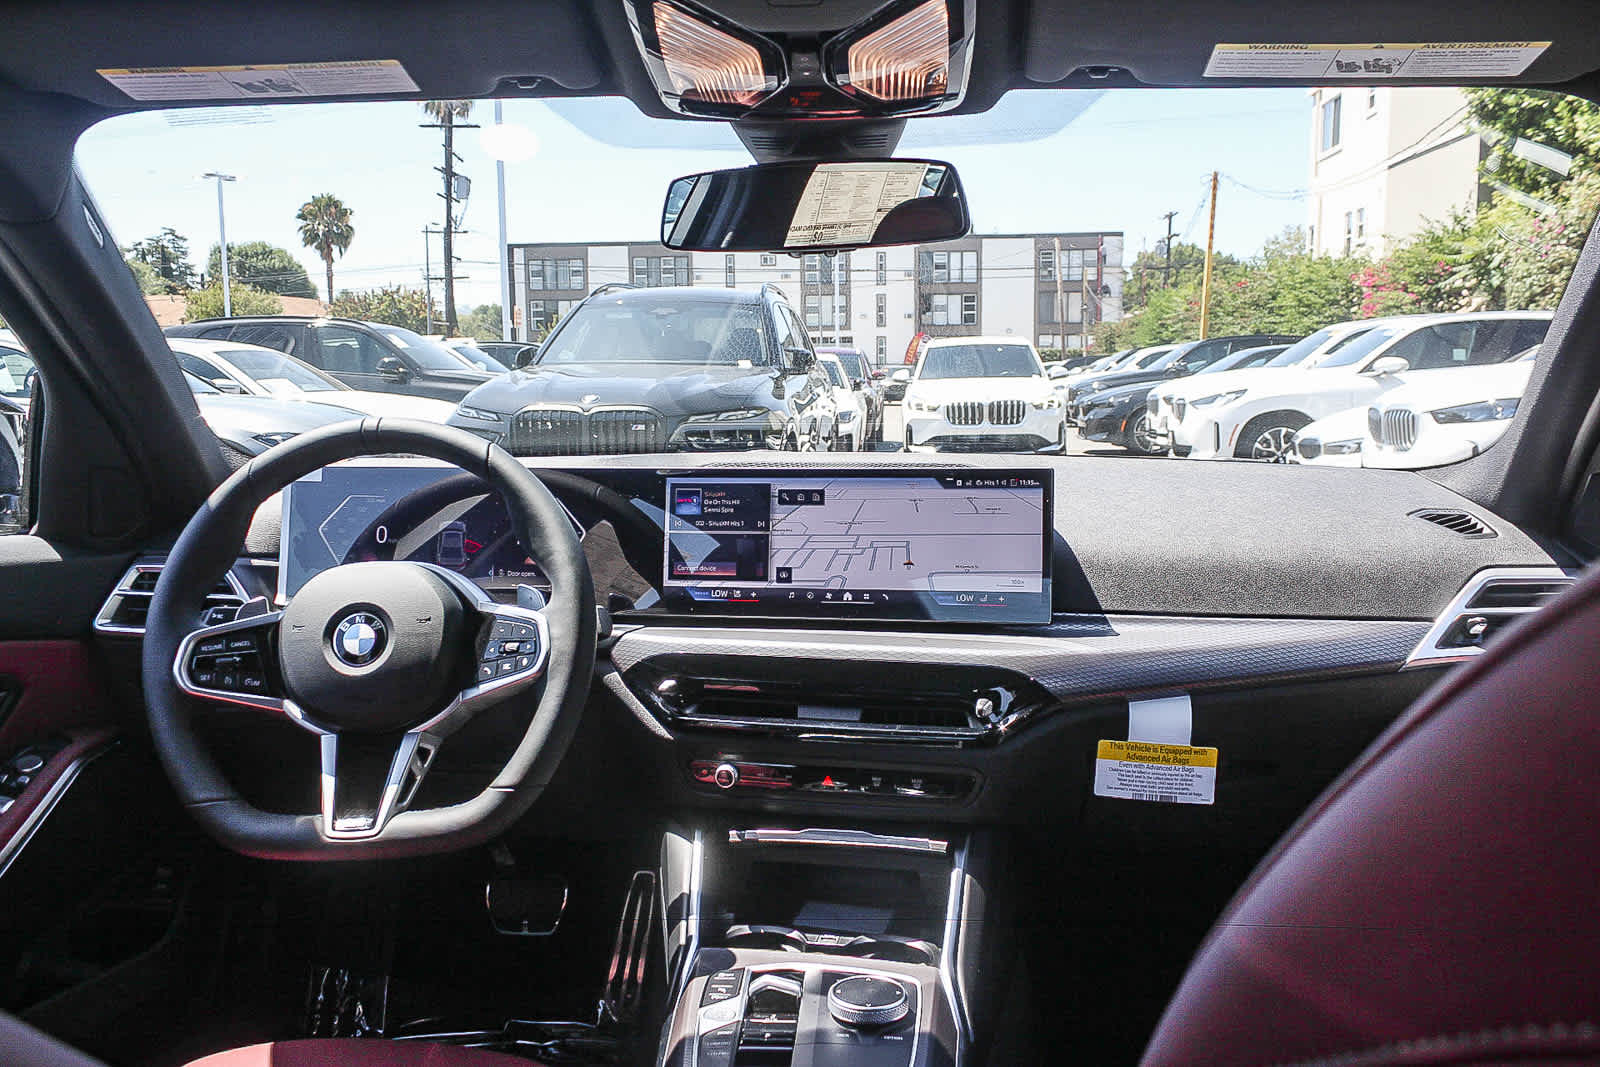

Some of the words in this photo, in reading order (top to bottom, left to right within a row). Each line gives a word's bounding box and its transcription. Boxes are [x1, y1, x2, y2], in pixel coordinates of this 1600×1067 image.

[376, 526, 388, 544] 0
[340, 616, 382, 632] BMW
[1109, 742, 1124, 750] This
[1126, 743, 1151, 752] Vehicle
[1160, 746, 1192, 757] Equipped
[1126, 752, 1160, 762] Advanced
[1174, 756, 1189, 765] Bags
[1146, 763, 1172, 771] Advanced
[1181, 766, 1194, 774] Bags
